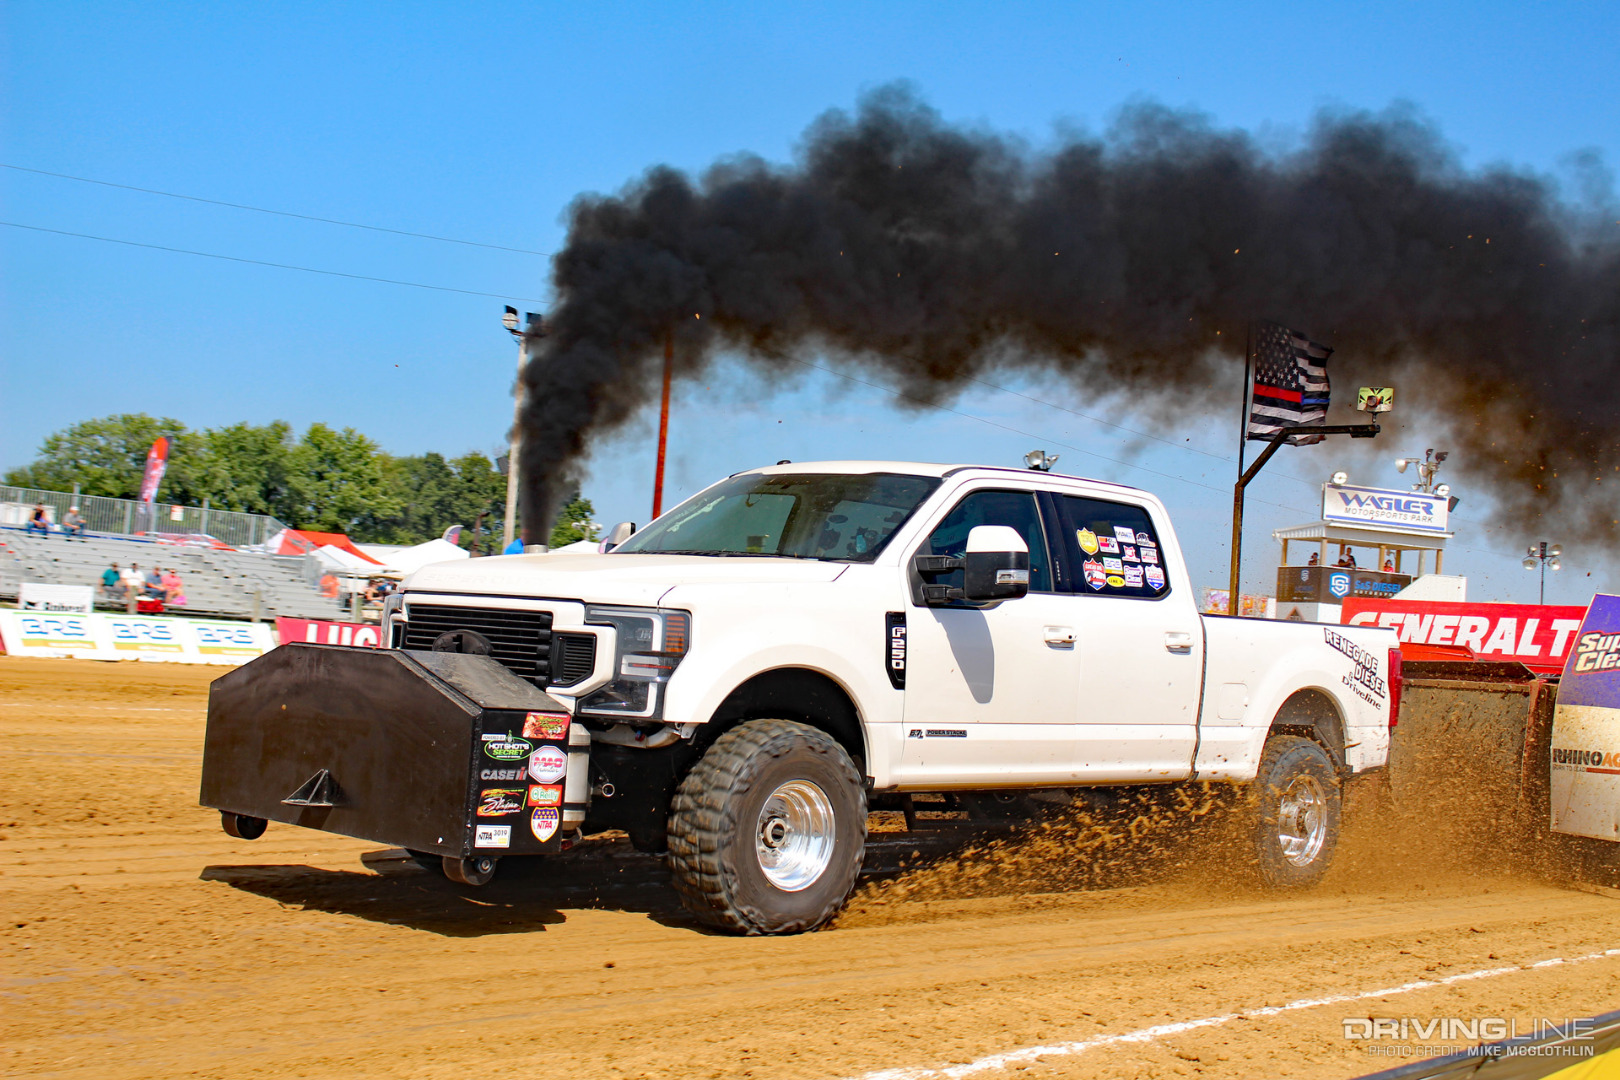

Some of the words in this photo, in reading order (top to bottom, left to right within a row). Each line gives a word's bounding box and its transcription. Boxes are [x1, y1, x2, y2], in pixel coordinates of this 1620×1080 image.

[1338, 491, 1434, 516] WAGLER
[1345, 507, 1408, 521] MOTORSPORTS
[1410, 514, 1433, 523] PARK
[1323, 627, 1379, 677] RENEGADE
[1341, 675, 1382, 710] Driveline
[1354, 662, 1387, 699] DIESEL
[481, 769, 515, 780] CASE
